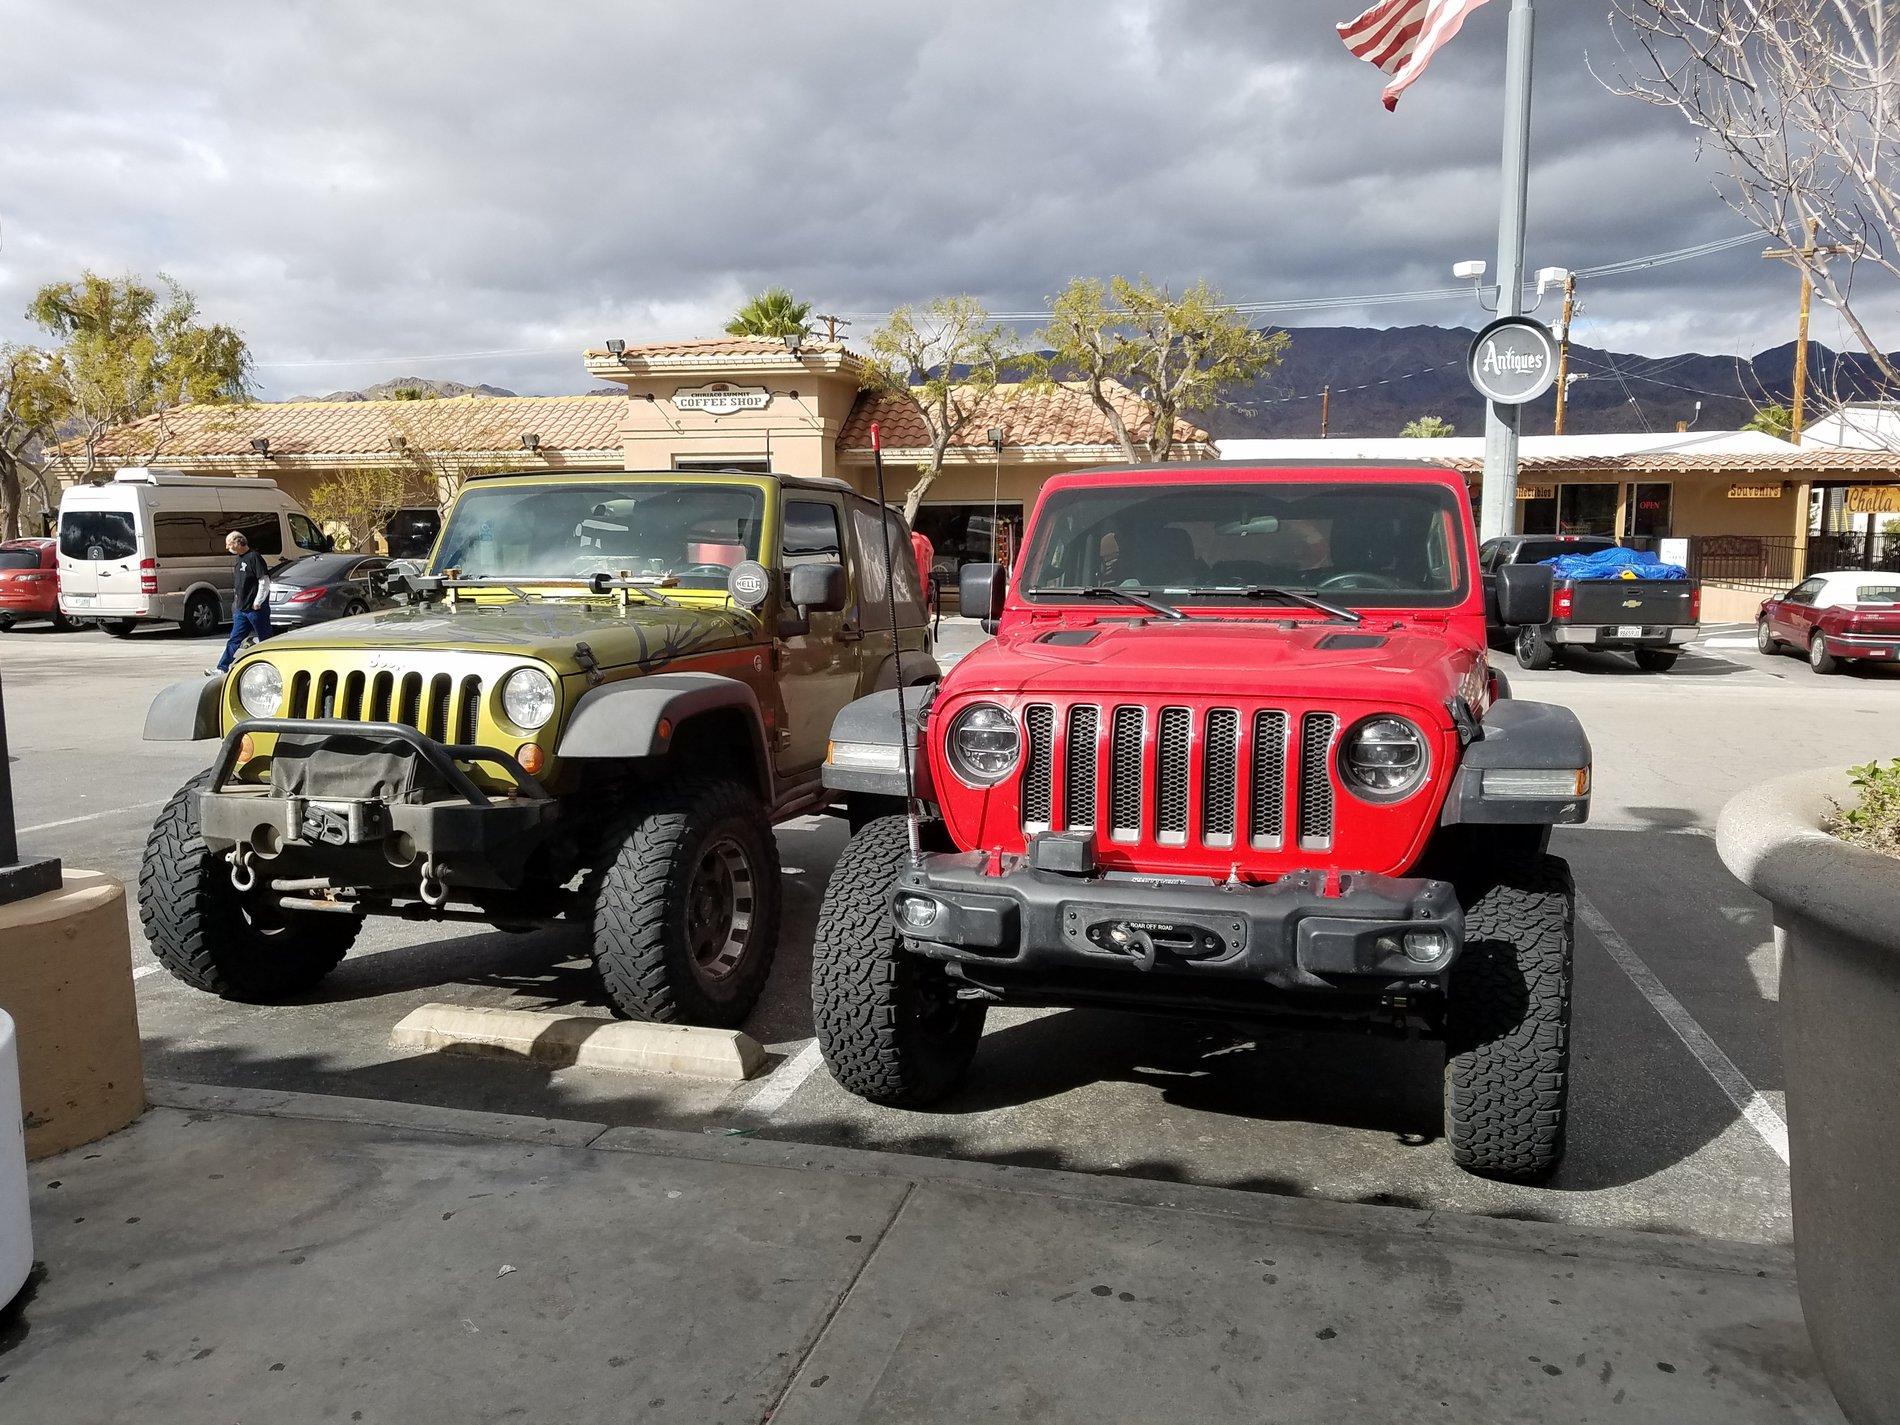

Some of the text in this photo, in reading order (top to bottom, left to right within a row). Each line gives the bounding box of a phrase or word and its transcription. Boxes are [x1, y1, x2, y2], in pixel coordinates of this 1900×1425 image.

[1483, 340, 1544, 376] Antiques
[680, 397, 762, 407] COFFEE SHOP
[1731, 483, 1779, 497] Souvenirs
[1640, 501, 1660, 510] OPEN
[1849, 487, 1893, 512] Cholla
[736, 580, 762, 589] HELLA
